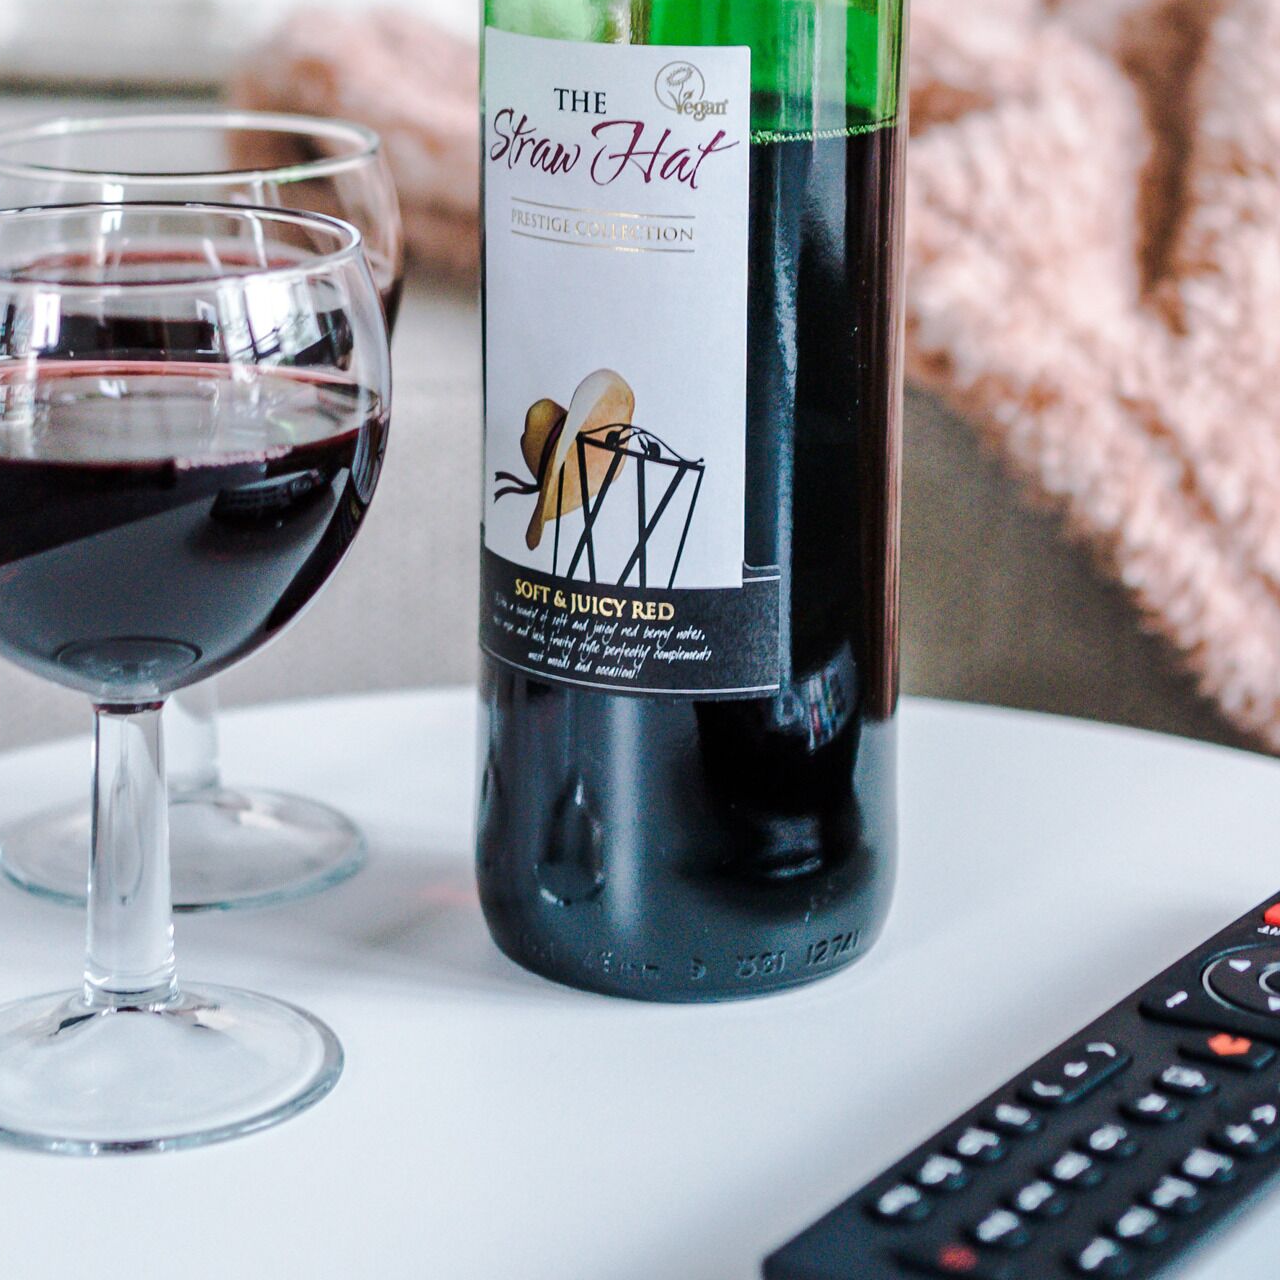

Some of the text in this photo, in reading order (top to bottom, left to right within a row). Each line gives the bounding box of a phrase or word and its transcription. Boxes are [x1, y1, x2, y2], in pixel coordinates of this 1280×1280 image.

[553, 87, 607, 115] THE
[675, 98, 727, 120] Vegan
[490, 107, 740, 189] Straw Hat
[510, 207, 694, 242] PRESTIGE COLLECTION
[514, 578, 551, 604] SOFT
[553, 589, 568, 609] &
[570, 593, 626, 618] JUICY
[631, 600, 675, 621] RED
[571, 618, 590, 632] and
[586, 620, 619, 645] juicy
[620, 623, 640, 637] red
[642, 625, 674, 649] berry
[574, 660, 593, 673] and
[602, 641, 652, 668] perfectly
[653, 645, 713, 664] complements
